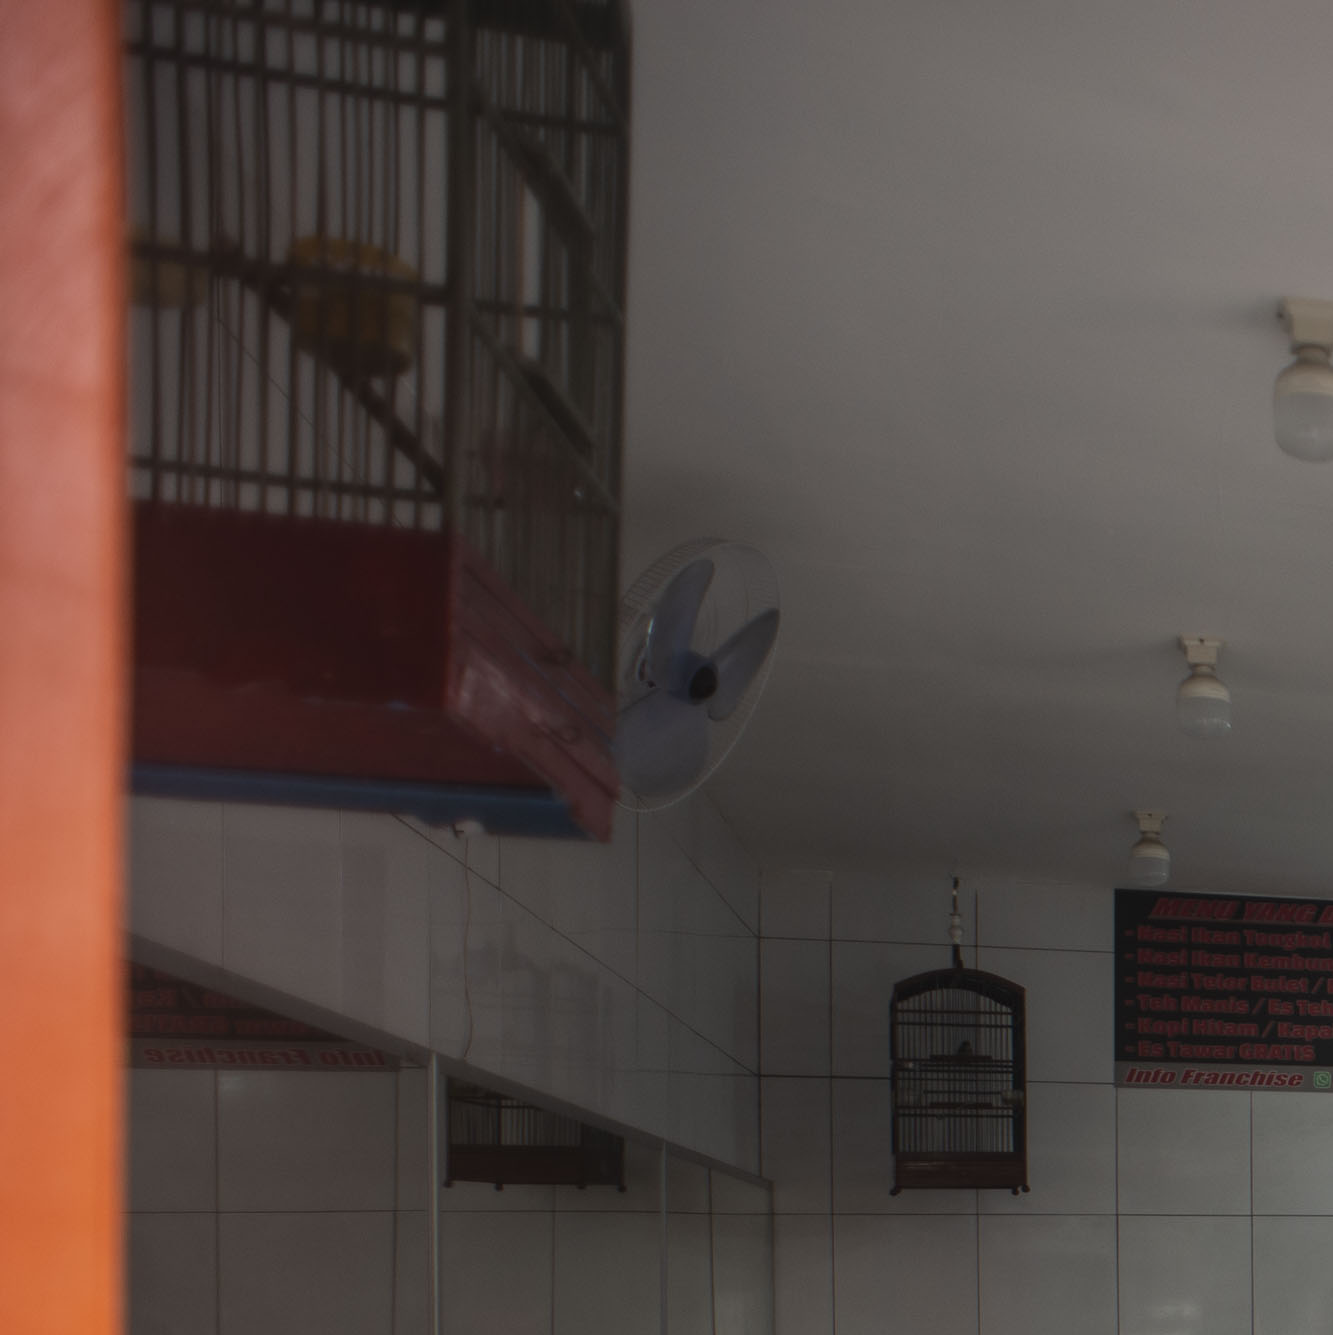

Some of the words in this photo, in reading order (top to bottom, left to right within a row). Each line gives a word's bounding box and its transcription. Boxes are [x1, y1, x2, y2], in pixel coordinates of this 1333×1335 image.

[1151, 897, 1240, 920] MENU
[1243, 901, 1318, 923] YANG
[1136, 925, 1188, 943] Nasi
[1191, 927, 1240, 945] Ikan
[1136, 948, 1188, 966] Nasi
[1191, 949, 1240, 967] Ikan
[1136, 971, 1188, 990] Nasi
[1190, 973, 1248, 991] Telor
[1136, 994, 1176, 1012] Teh
[1181, 996, 1249, 1015] Manis
[1268, 998, 1294, 1016] Es
[1136, 1017, 1189, 1038] Kopi
[1191, 1019, 1258, 1037] Hitam
[1137, 1040, 1164, 1057] Es
[1166, 1041, 1238, 1059] Tawar
[1238, 1043, 1316, 1062] GRATIS
[1125, 1067, 1176, 1084] Info
[1180, 1068, 1304, 1087] Franchise
